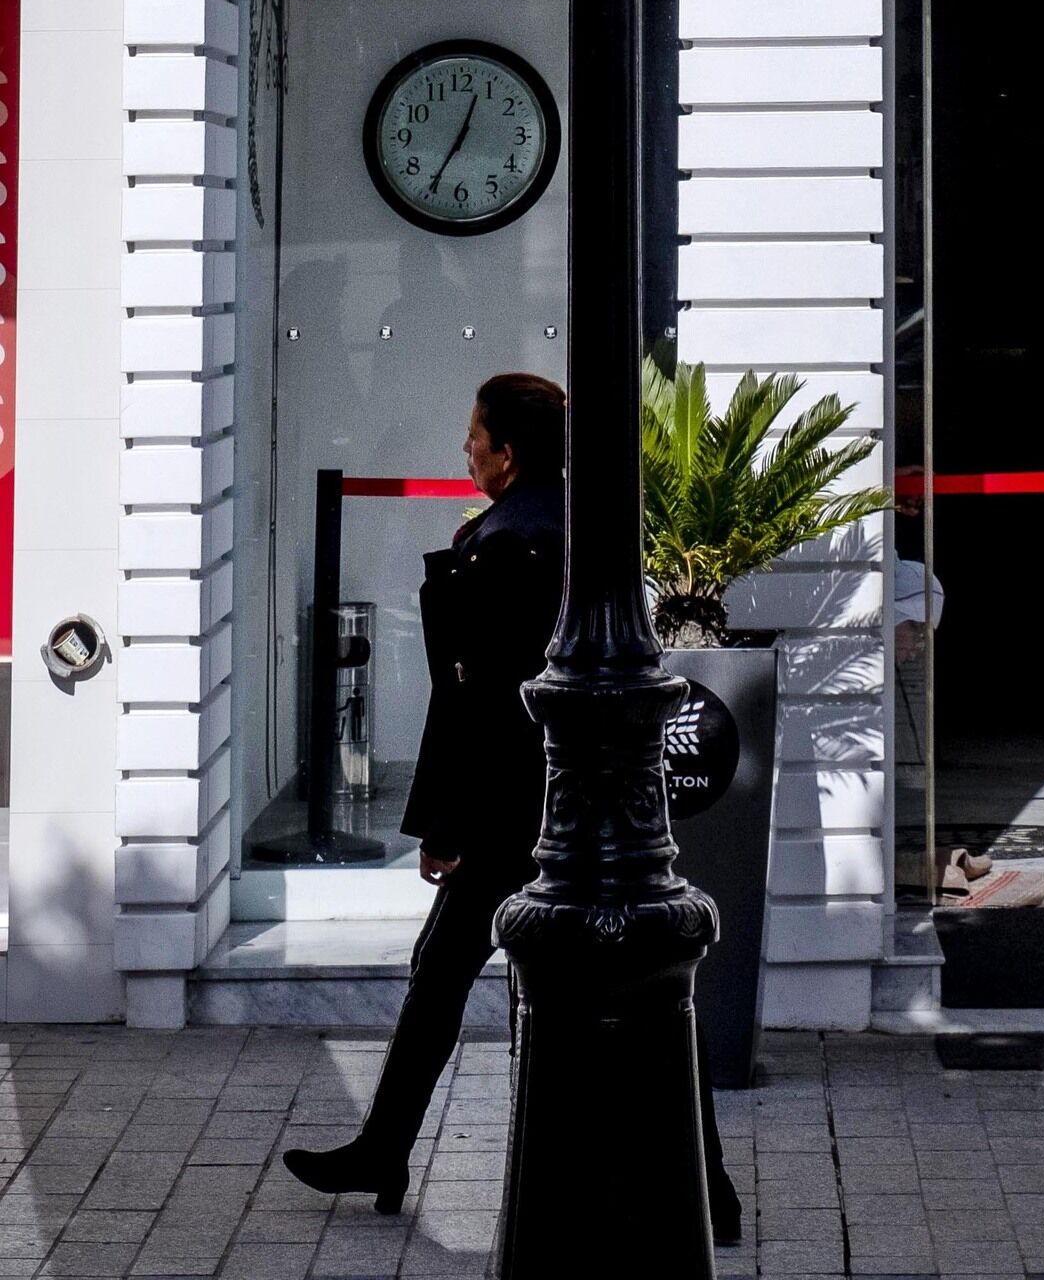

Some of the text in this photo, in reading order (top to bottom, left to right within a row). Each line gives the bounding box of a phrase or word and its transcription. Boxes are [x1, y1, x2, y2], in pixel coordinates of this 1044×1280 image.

[427, 82, 445, 102] 11
[451, 73, 473, 93] 12
[485, 80, 493, 100] 1
[407, 103, 429, 123] 10
[502, 97, 516, 117] 2
[397, 128, 412, 149] 9
[513, 126, 527, 145] 3
[406, 156, 421, 176] 8
[503, 153, 517, 172] 4
[429, 175, 442, 194] 7
[454, 181, 469, 202] 6
[486, 174, 499, 194] 5
